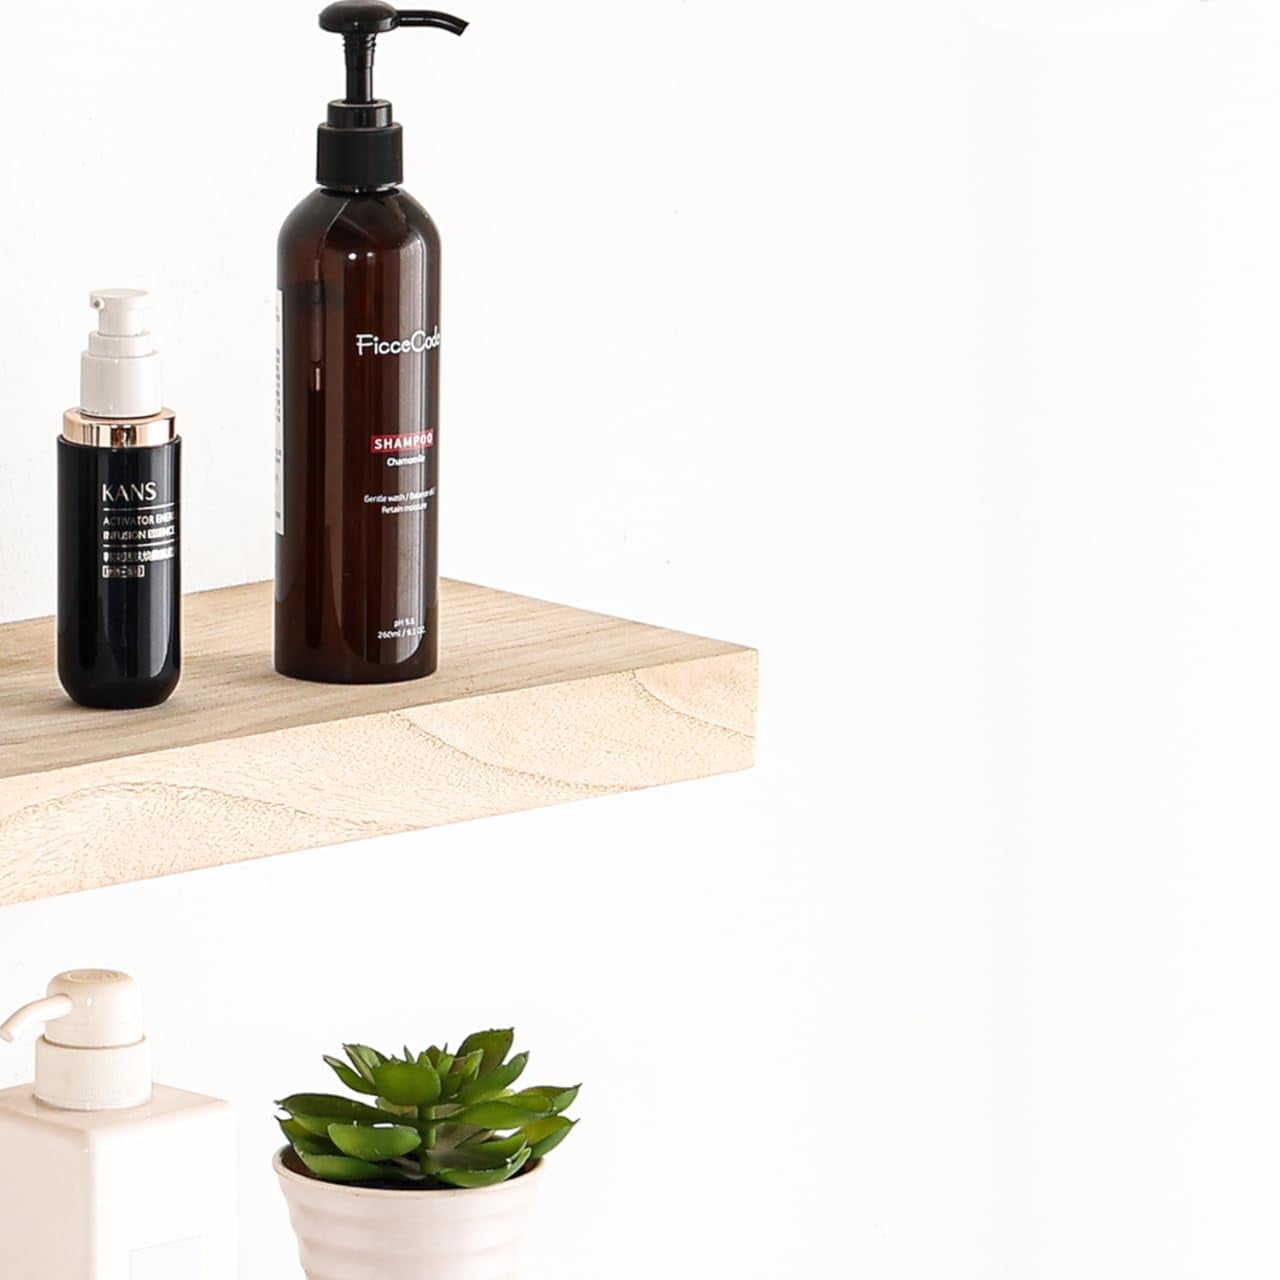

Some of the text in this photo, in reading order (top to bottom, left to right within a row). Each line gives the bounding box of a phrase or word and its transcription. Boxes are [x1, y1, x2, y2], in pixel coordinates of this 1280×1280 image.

[374, 432, 433, 450] SHAMPOO
[102, 482, 157, 502] KANS
[103, 515, 154, 526] ACTIVATOR
